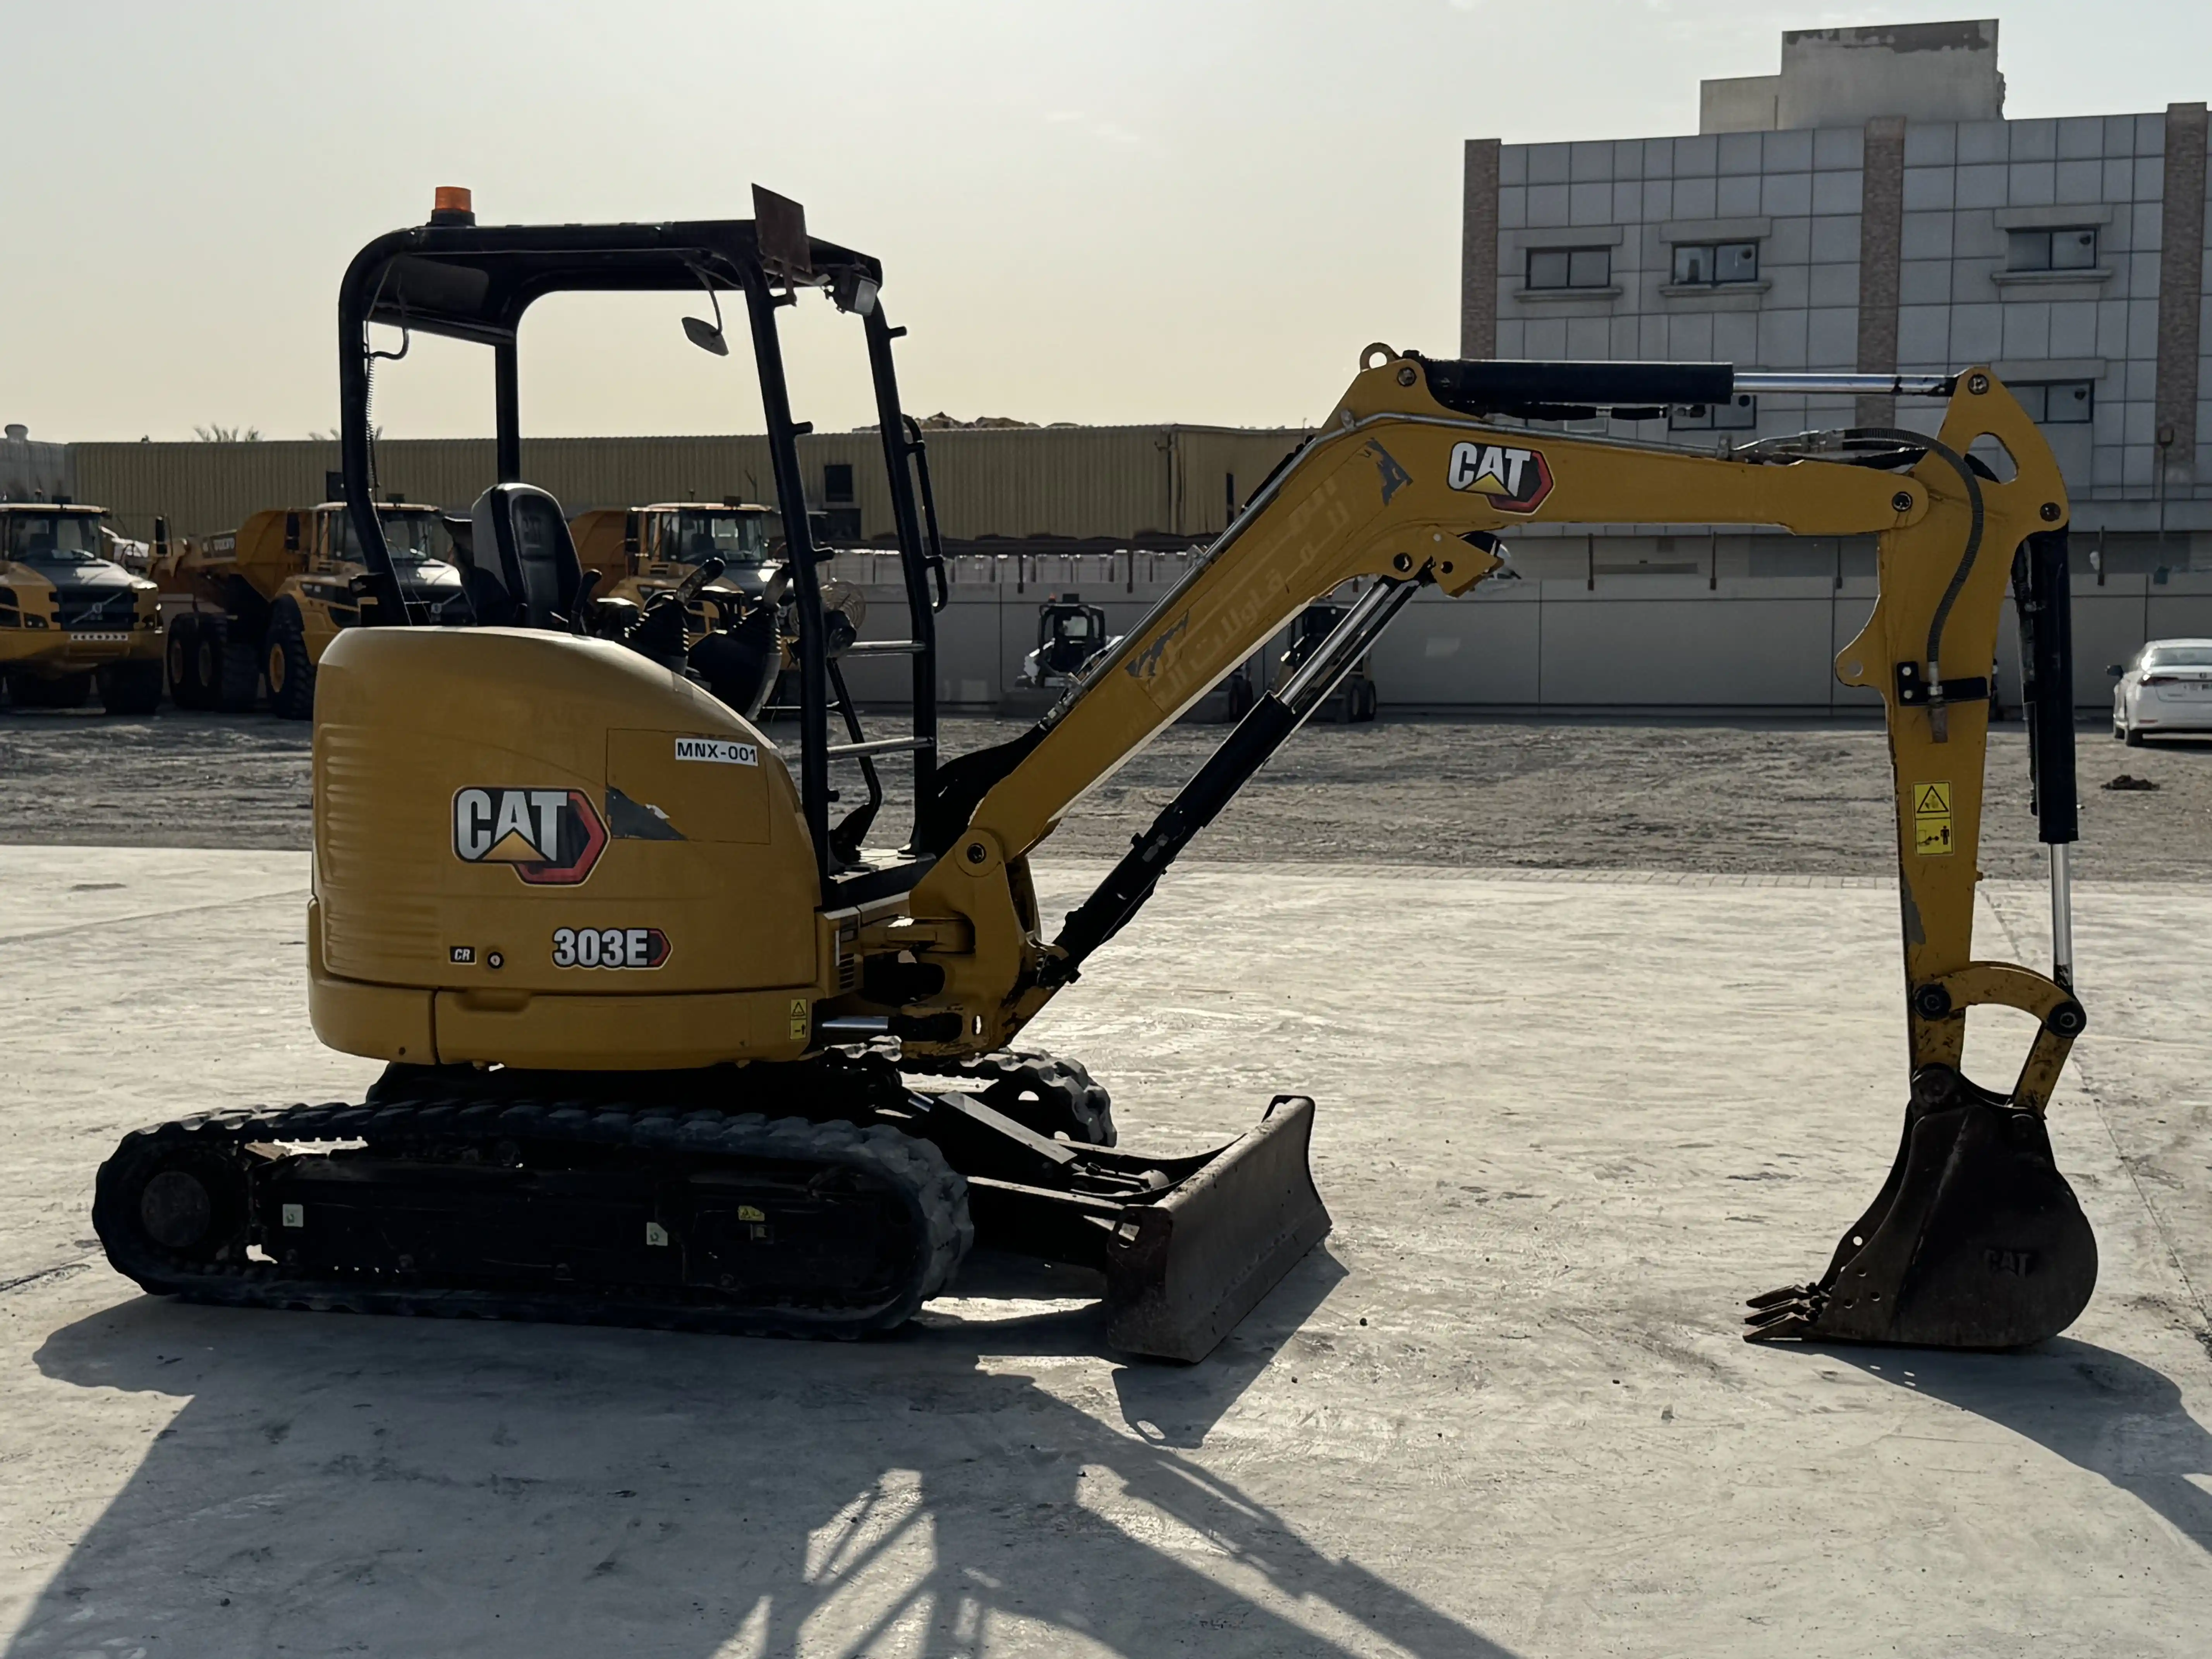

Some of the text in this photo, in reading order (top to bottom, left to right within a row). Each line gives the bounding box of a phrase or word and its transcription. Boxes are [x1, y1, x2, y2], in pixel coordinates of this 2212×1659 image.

[1449, 443, 1531, 497] CAT
[677, 742, 756, 763] MNX-001
[458, 789, 568, 861] CAT
[455, 948, 470, 960] CR
[554, 929, 647, 966] 303E
[1983, 1249, 2032, 1278] CAT
